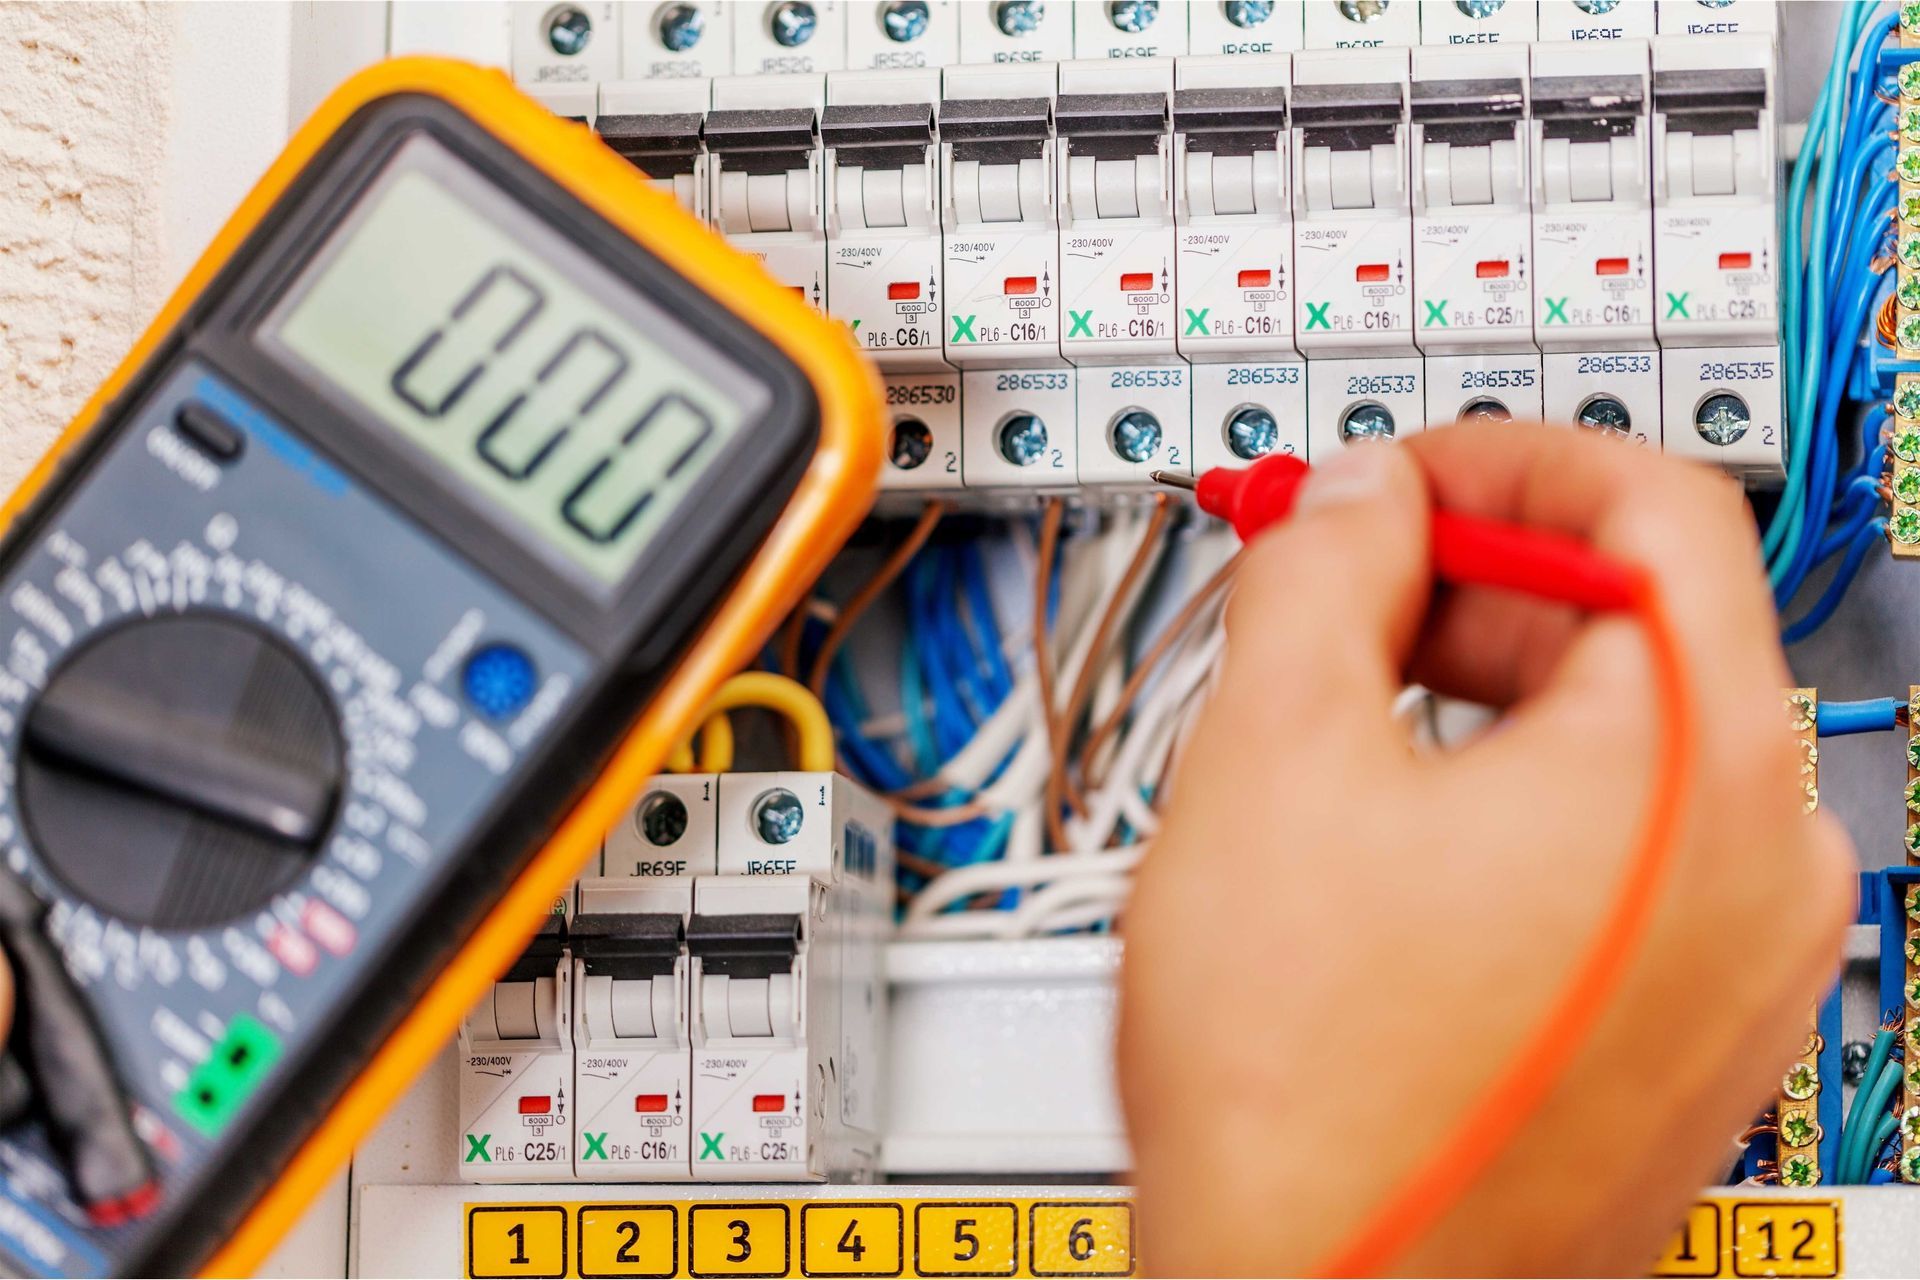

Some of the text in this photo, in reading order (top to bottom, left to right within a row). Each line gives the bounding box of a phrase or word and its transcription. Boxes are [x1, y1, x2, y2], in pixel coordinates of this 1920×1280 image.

[1578, 356, 1650, 373] 286533
[1700, 362, 1774, 380] 286535
[997, 374, 1068, 390] 286533
[1111, 370, 1182, 387] 286533
[1228, 368, 1299, 385] 286533
[1347, 376, 1415, 394] 286533
[1462, 370, 1535, 388] 286535
[886, 386, 955, 404] 286530
[1762, 426, 1774, 445] 2
[945, 452, 956, 472] 2
[1052, 450, 1064, 467] 2
[1168, 447, 1180, 464] 2
[630, 861, 686, 876] JR69F
[741, 861, 797, 876] JR65F
[506, 1224, 530, 1264] 1
[616, 1222, 641, 1263] 2
[727, 1220, 751, 1262] 3
[837, 1219, 866, 1262] 4
[953, 1220, 980, 1261] 5
[1068, 1218, 1095, 1260] 6
[1757, 1221, 1815, 1261] 12
